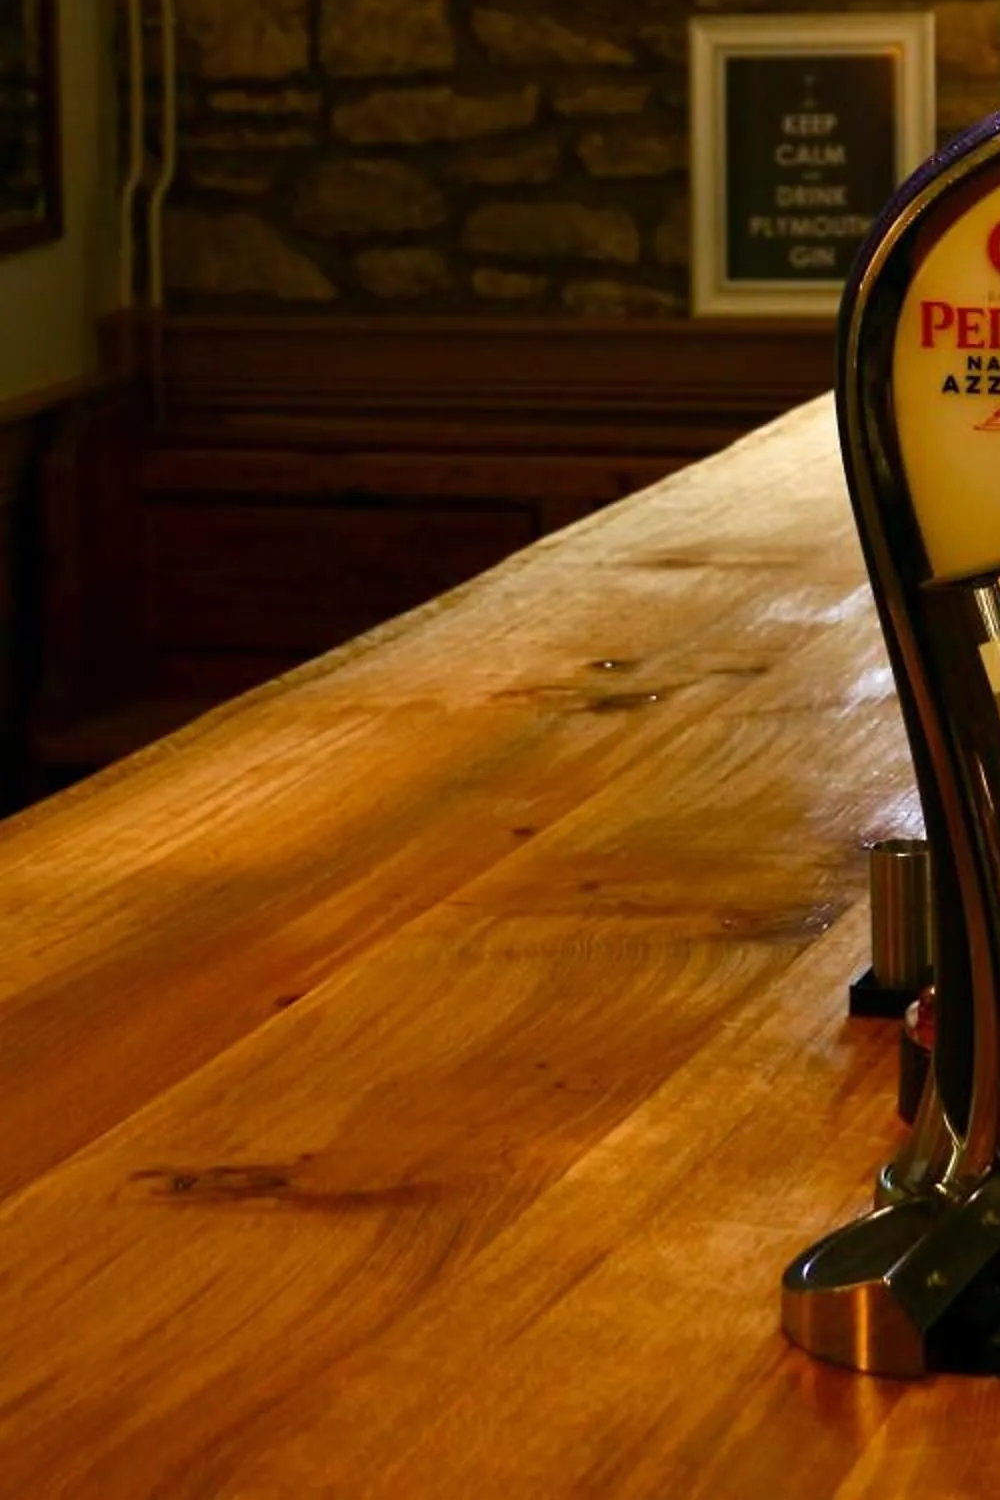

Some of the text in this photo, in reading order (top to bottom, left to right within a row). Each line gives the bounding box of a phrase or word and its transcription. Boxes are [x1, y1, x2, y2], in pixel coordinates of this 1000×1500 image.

[781, 113, 838, 136] KEEP
[775, 144, 847, 166] CALM
[775, 186, 848, 207] DRINK
[788, 245, 836, 267] GIN
